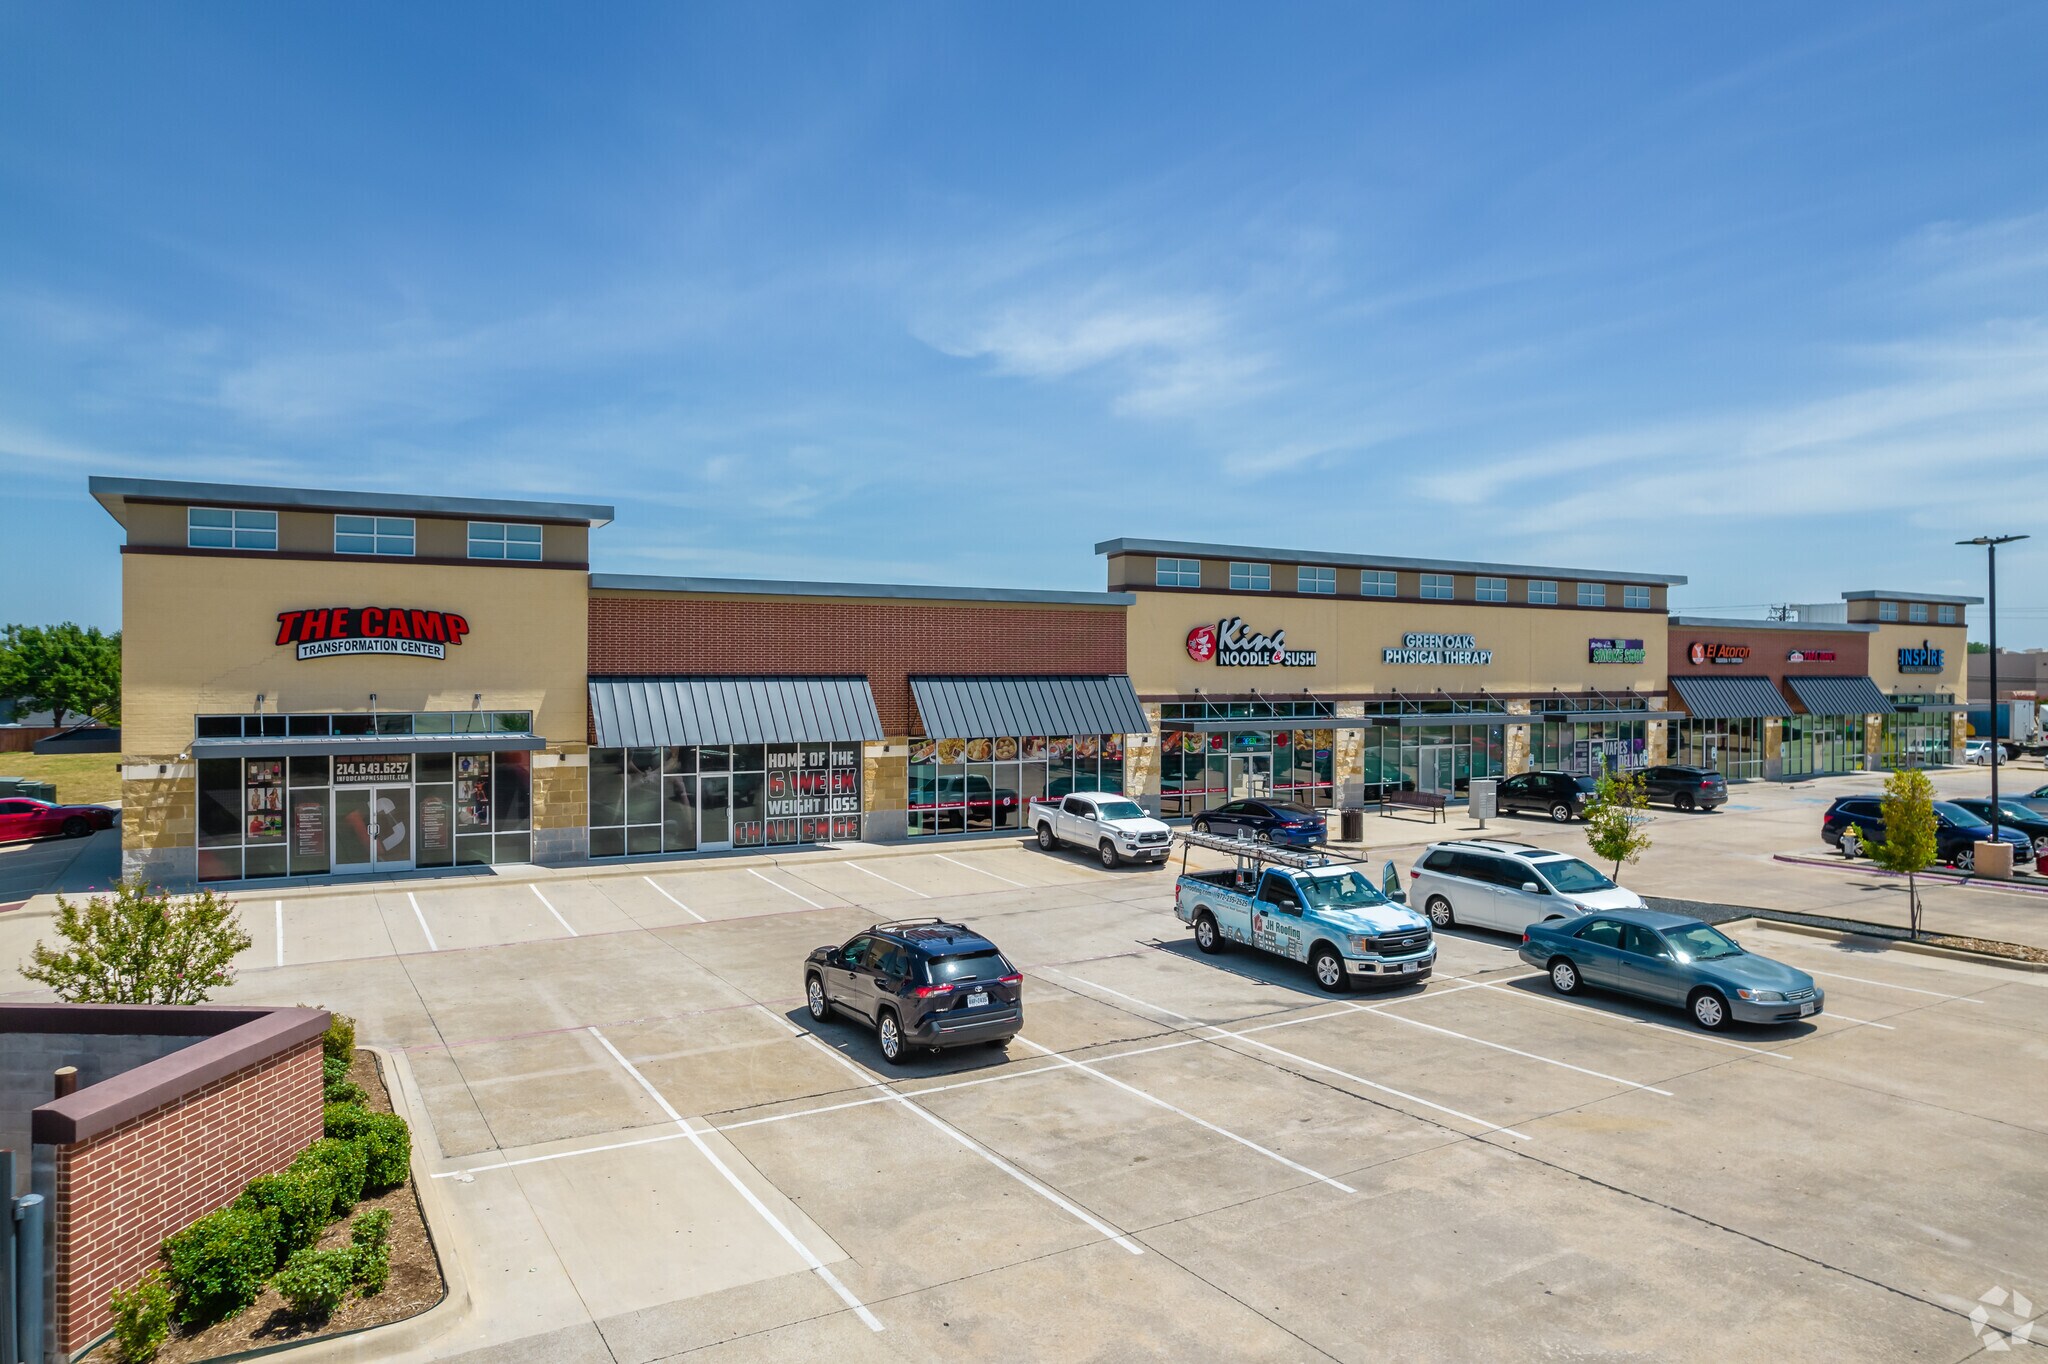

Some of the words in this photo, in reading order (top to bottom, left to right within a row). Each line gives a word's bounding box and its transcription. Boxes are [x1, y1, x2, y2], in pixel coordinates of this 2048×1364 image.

[276, 607, 350, 645] THE
[360, 606, 470, 645] CAMP
[1218, 617, 1286, 658] King
[1405, 633, 1443, 648] GREEN
[1445, 634, 1476, 649] OAKS
[302, 640, 398, 656] TRANSFORMATION
[401, 641, 441, 656] CENTER
[1593, 648, 1624, 663] SMOKE
[1624, 648, 1646, 663] SHOP
[1706, 644, 1716, 657] El
[1717, 644, 1751, 658] Atoron
[1901, 640, 1945, 666] INSPIRE
[1220, 651, 1270, 665] NOODLE
[1284, 651, 1317, 666] SUSHI
[1385, 649, 1442, 664] PHYSICAL
[1444, 650, 1493, 665] THERAPY
[768, 752, 806, 768] HOME
[809, 751, 826, 767] OF
[831, 750, 854, 766] THE
[336, 762, 409, 775] 214.643.6257
[768, 770, 785, 798] 6
[788, 767, 857, 797] WEEK
[767, 799, 821, 815] WEIGHT
[824, 796, 858, 812] LOSS
[733, 815, 858, 846] CHALLENGE
[1216, 892, 1249, 907] 972-235-2525
[1265, 919, 1274, 931] JH
[1275, 920, 1301, 941] Roofing
